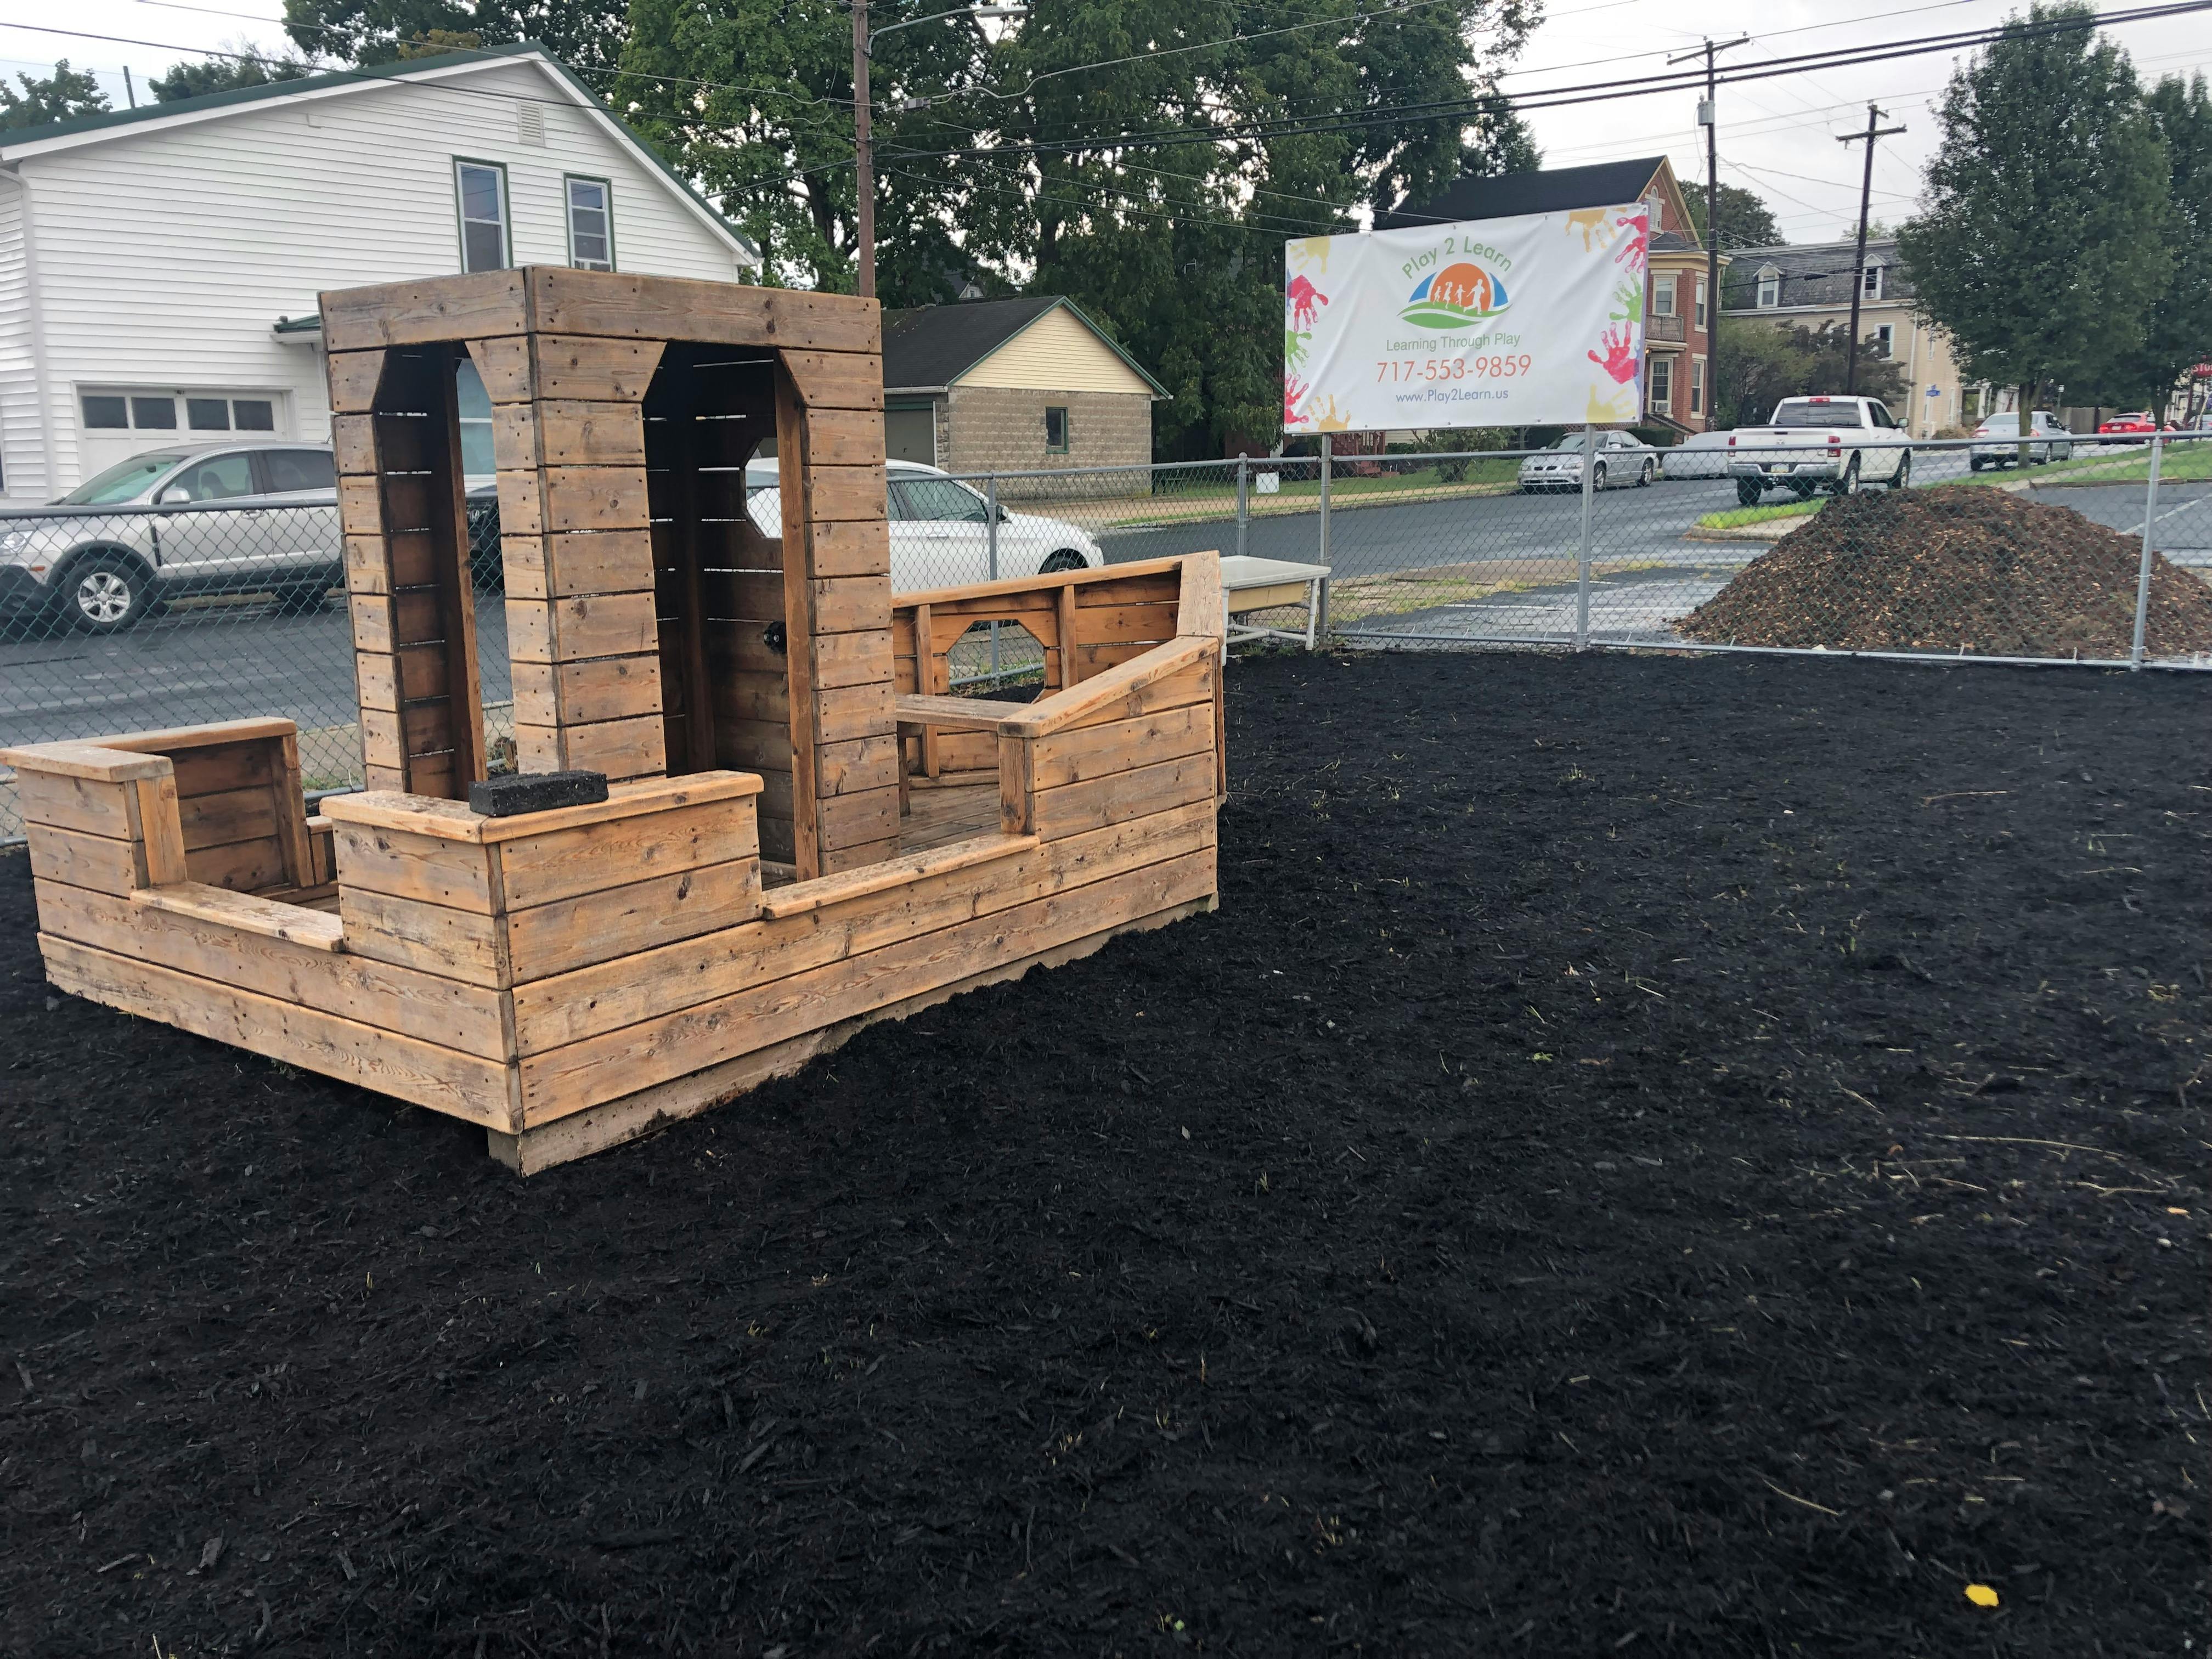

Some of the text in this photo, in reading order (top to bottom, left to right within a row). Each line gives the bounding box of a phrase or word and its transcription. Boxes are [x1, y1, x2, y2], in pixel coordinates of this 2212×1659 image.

[1402, 236, 1512, 279] Play 2 Learn
[1386, 333, 1520, 352] Learning Through Play
[1377, 355, 1532, 382] 717-553-9859
[2193, 363, 2212, 372] STO
[1396, 388, 1509, 404] www.Play2Learn.us
